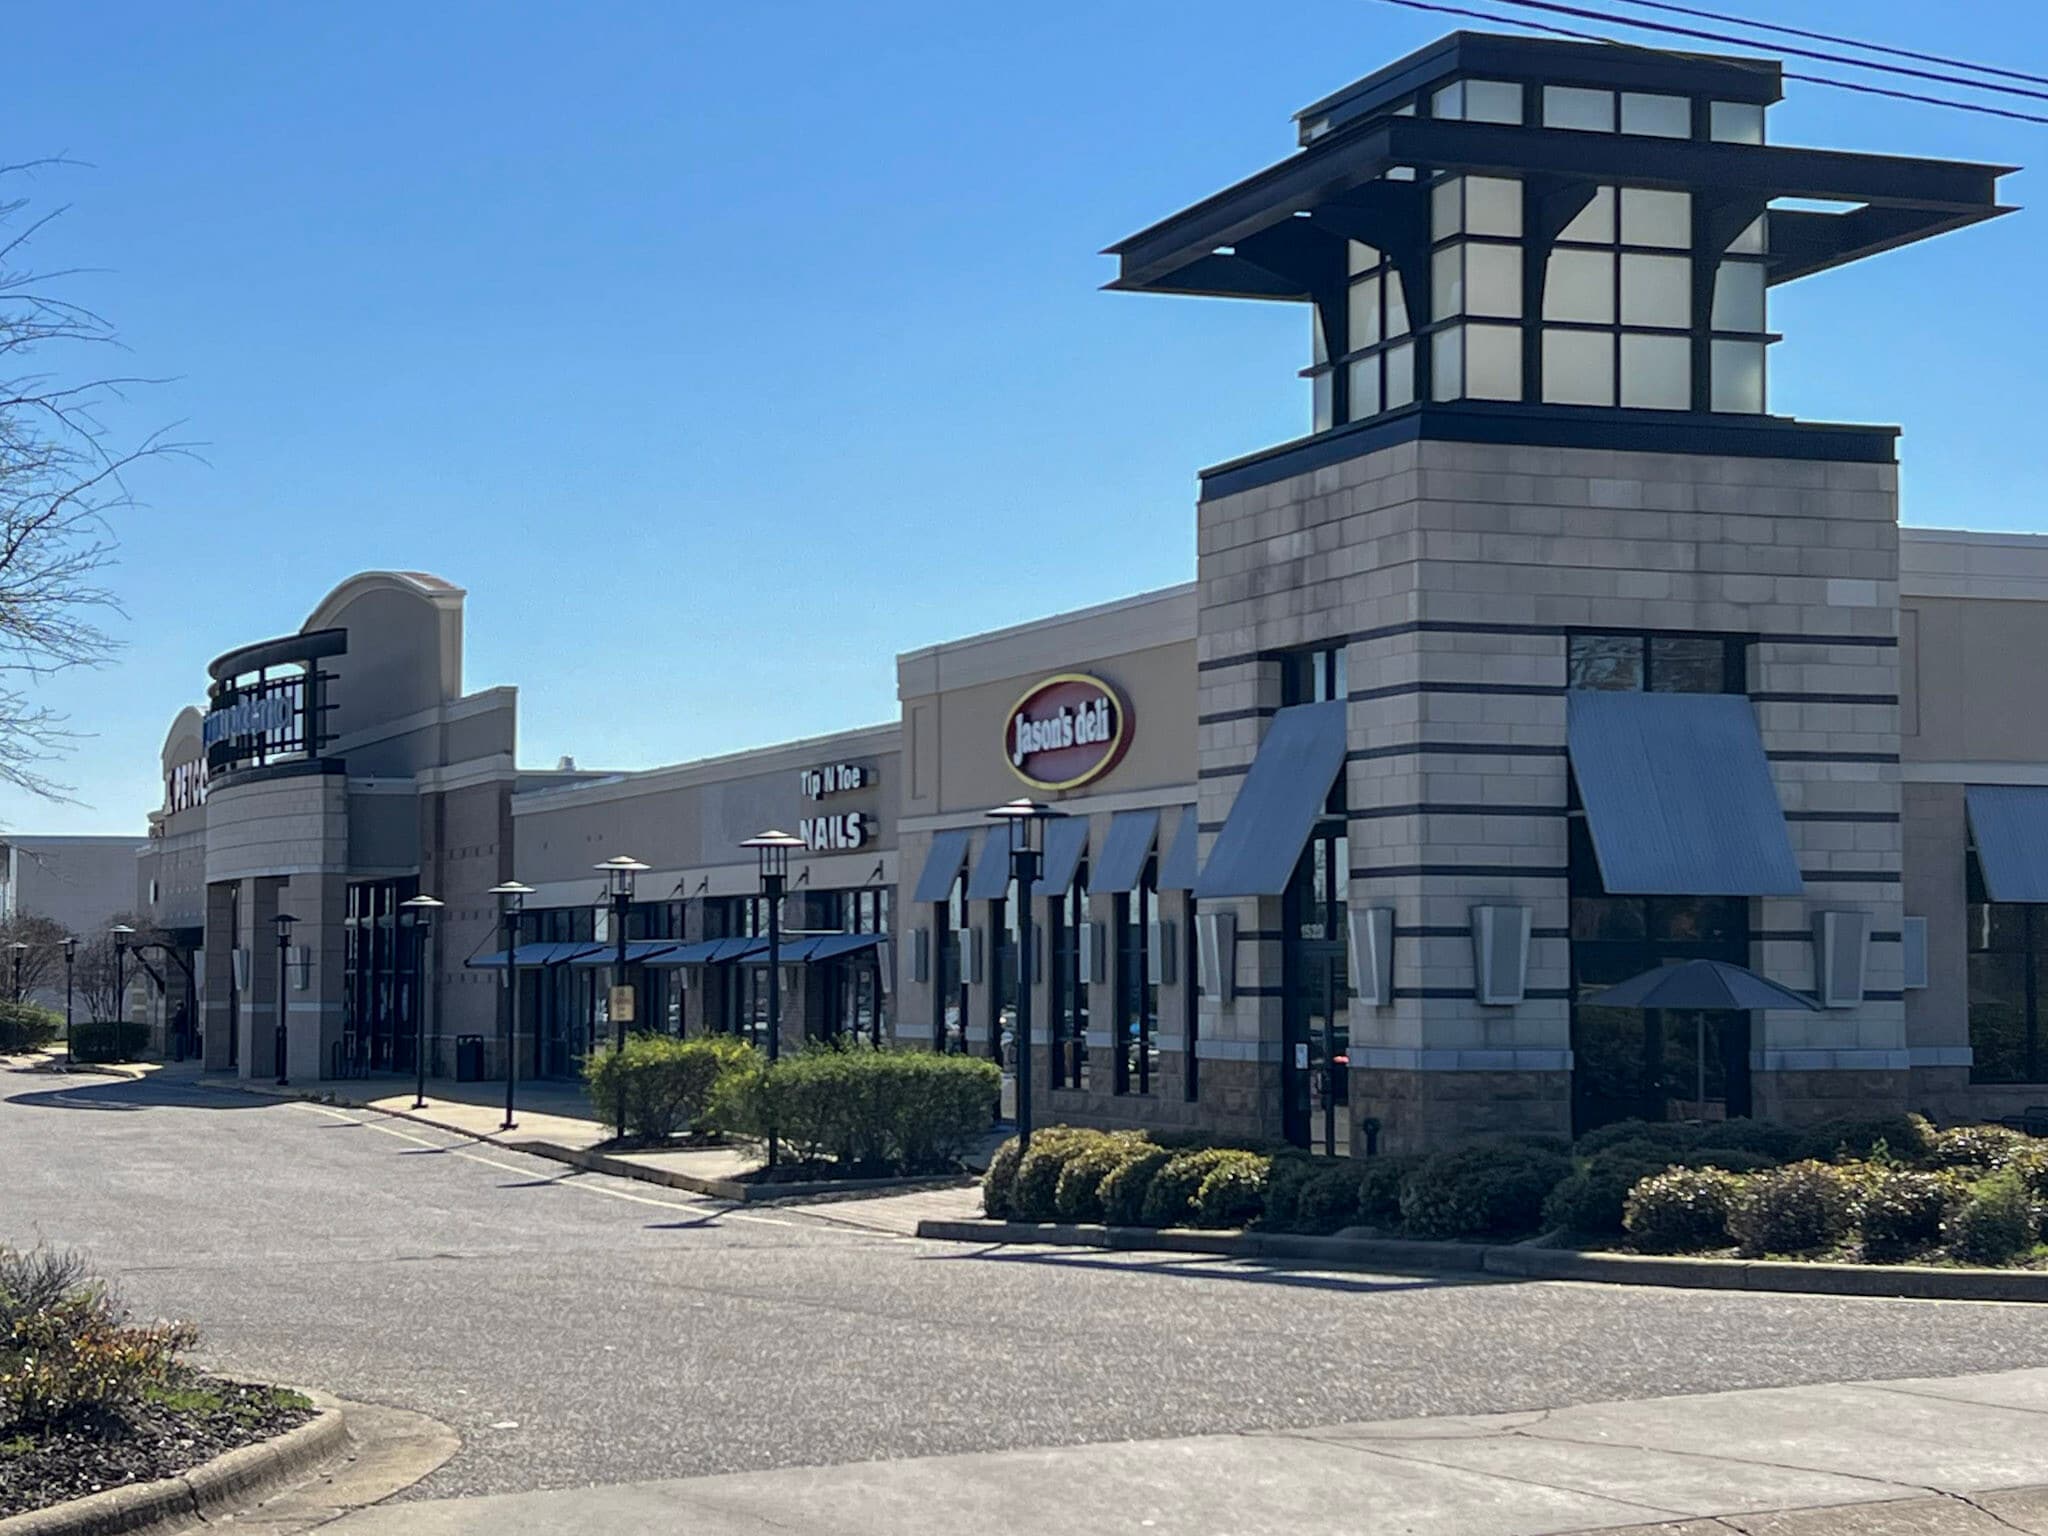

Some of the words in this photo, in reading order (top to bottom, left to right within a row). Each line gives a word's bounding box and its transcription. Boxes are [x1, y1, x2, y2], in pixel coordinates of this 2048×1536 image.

[1013, 706, 1072, 767] Jason's
[1075, 697, 1110, 745] deli
[801, 770, 821, 800] Tip
[824, 766, 835, 793] N
[837, 764, 861, 790] Toe
[800, 812, 861, 851] NAILS
